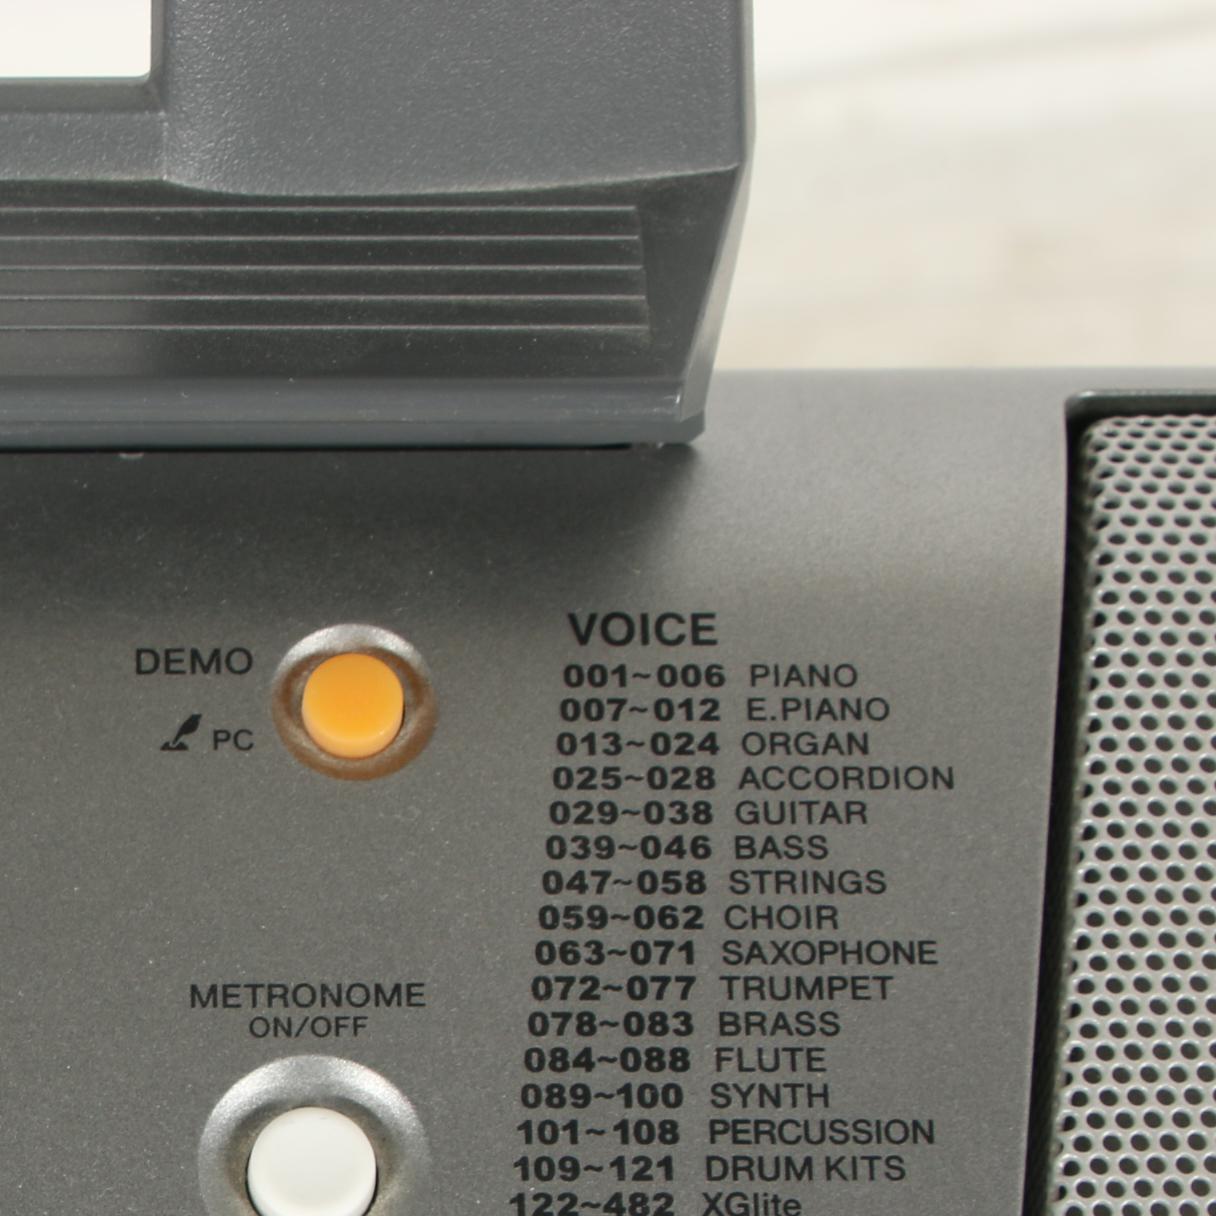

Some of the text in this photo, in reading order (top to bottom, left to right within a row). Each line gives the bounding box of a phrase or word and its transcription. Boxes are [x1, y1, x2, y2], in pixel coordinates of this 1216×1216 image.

[566, 611, 718, 647] VOICE
[135, 646, 254, 676] DEMO
[562, 663, 858, 689] 001~006 PIANO
[559, 697, 890, 723] 007~012 E.PIANO
[212, 728, 254, 752] PC
[556, 731, 870, 757] 013~024 ORGAN
[552, 765, 955, 792] 025~028 ACCORDION
[549, 799, 868, 826] 029~038 GUITAR
[545, 834, 829, 861] 039~046 BASS
[541, 868, 887, 896] 047~058 STRINGS
[538, 904, 839, 931] 059~062 CHOIR
[534, 939, 939, 966] 063~071 SAXOPHONE
[189, 982, 426, 1009] METRONOME
[531, 974, 894, 1002] 072~077 TRUMPET
[248, 1015, 368, 1039] ON/OFF
[527, 1010, 841, 1038] 078~083 BRASS
[523, 1046, 827, 1074] 084~088 FLUTE
[520, 1082, 830, 1110] 089~100 SYNTH
[516, 1118, 935, 1146] 101~108 PERCUSSION
[513, 1154, 906, 1182] 109~121 DRUM KITS
